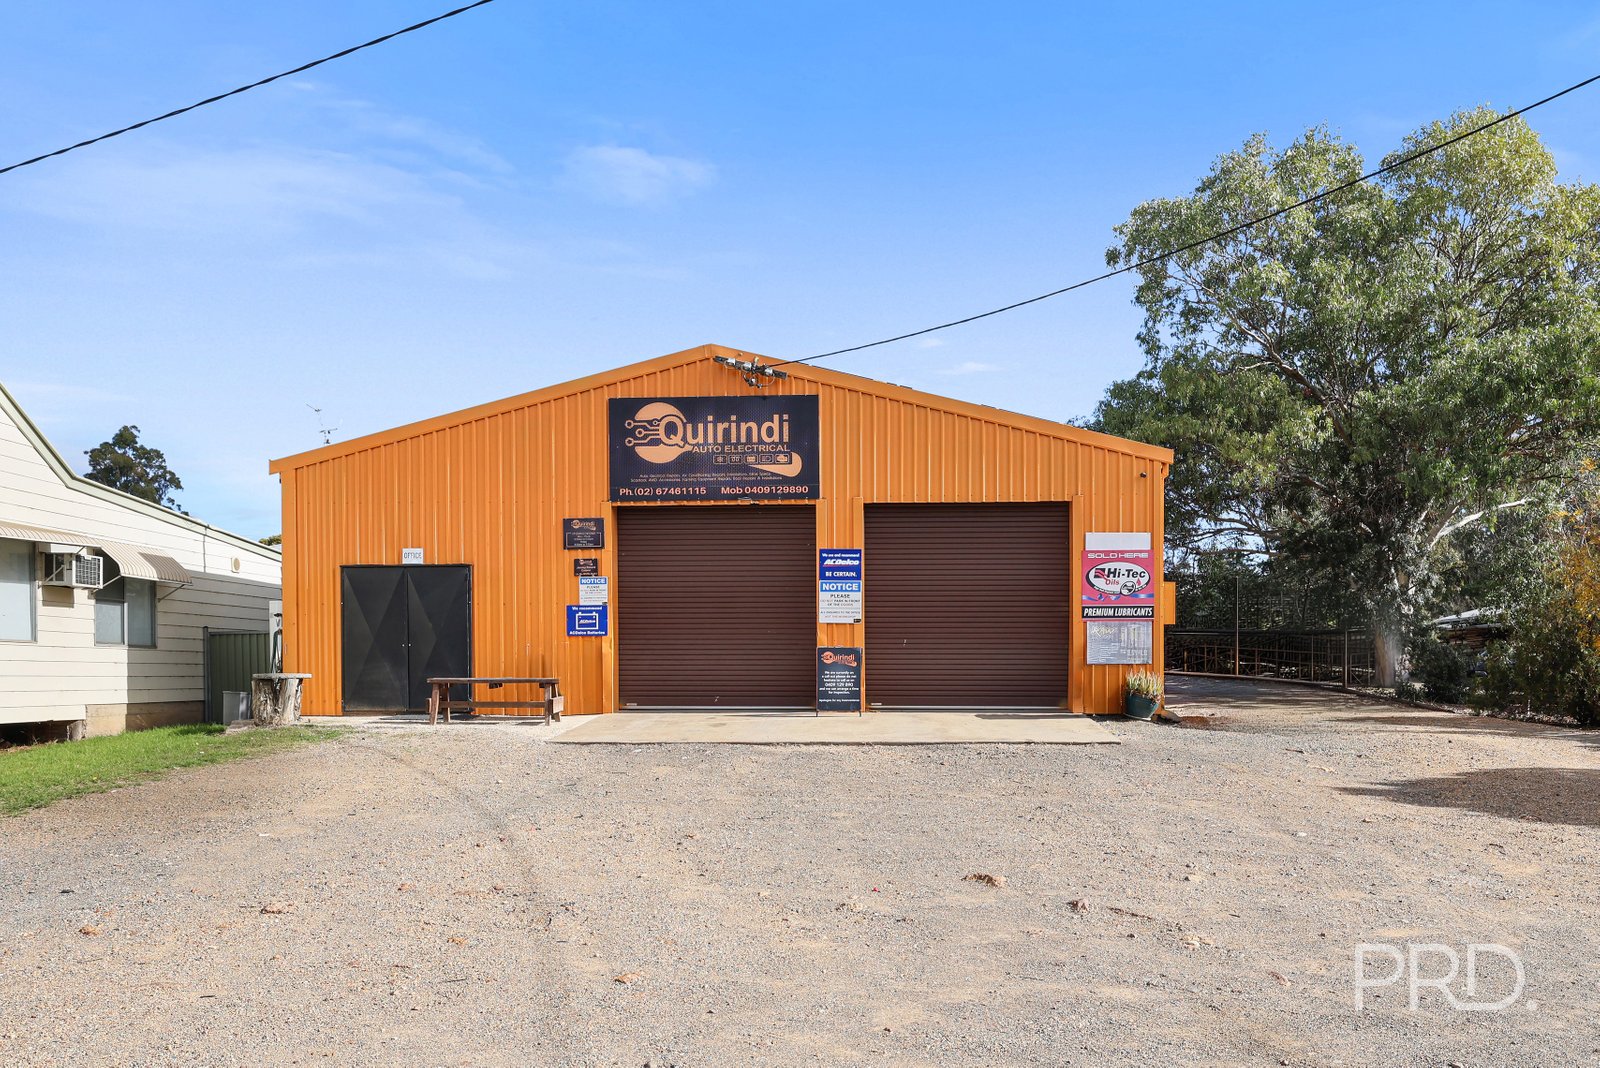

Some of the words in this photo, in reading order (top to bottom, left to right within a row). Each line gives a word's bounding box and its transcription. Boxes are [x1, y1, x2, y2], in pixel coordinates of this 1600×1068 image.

[659, 414, 789, 447] Quirindi
[692, 445, 721, 453] AUTO
[724, 444, 790, 453] ELECTRICAL
[655, 487, 706, 495] 67461115
[721, 486, 743, 494] Mob
[744, 485, 808, 494] 0409129890
[1107, 568, 1146, 578] Hi-Tec
[822, 583, 859, 591] NOTICE
[1084, 608, 1114, 616] PREMIUM
[1115, 607, 1152, 616] LUBRICANTS
